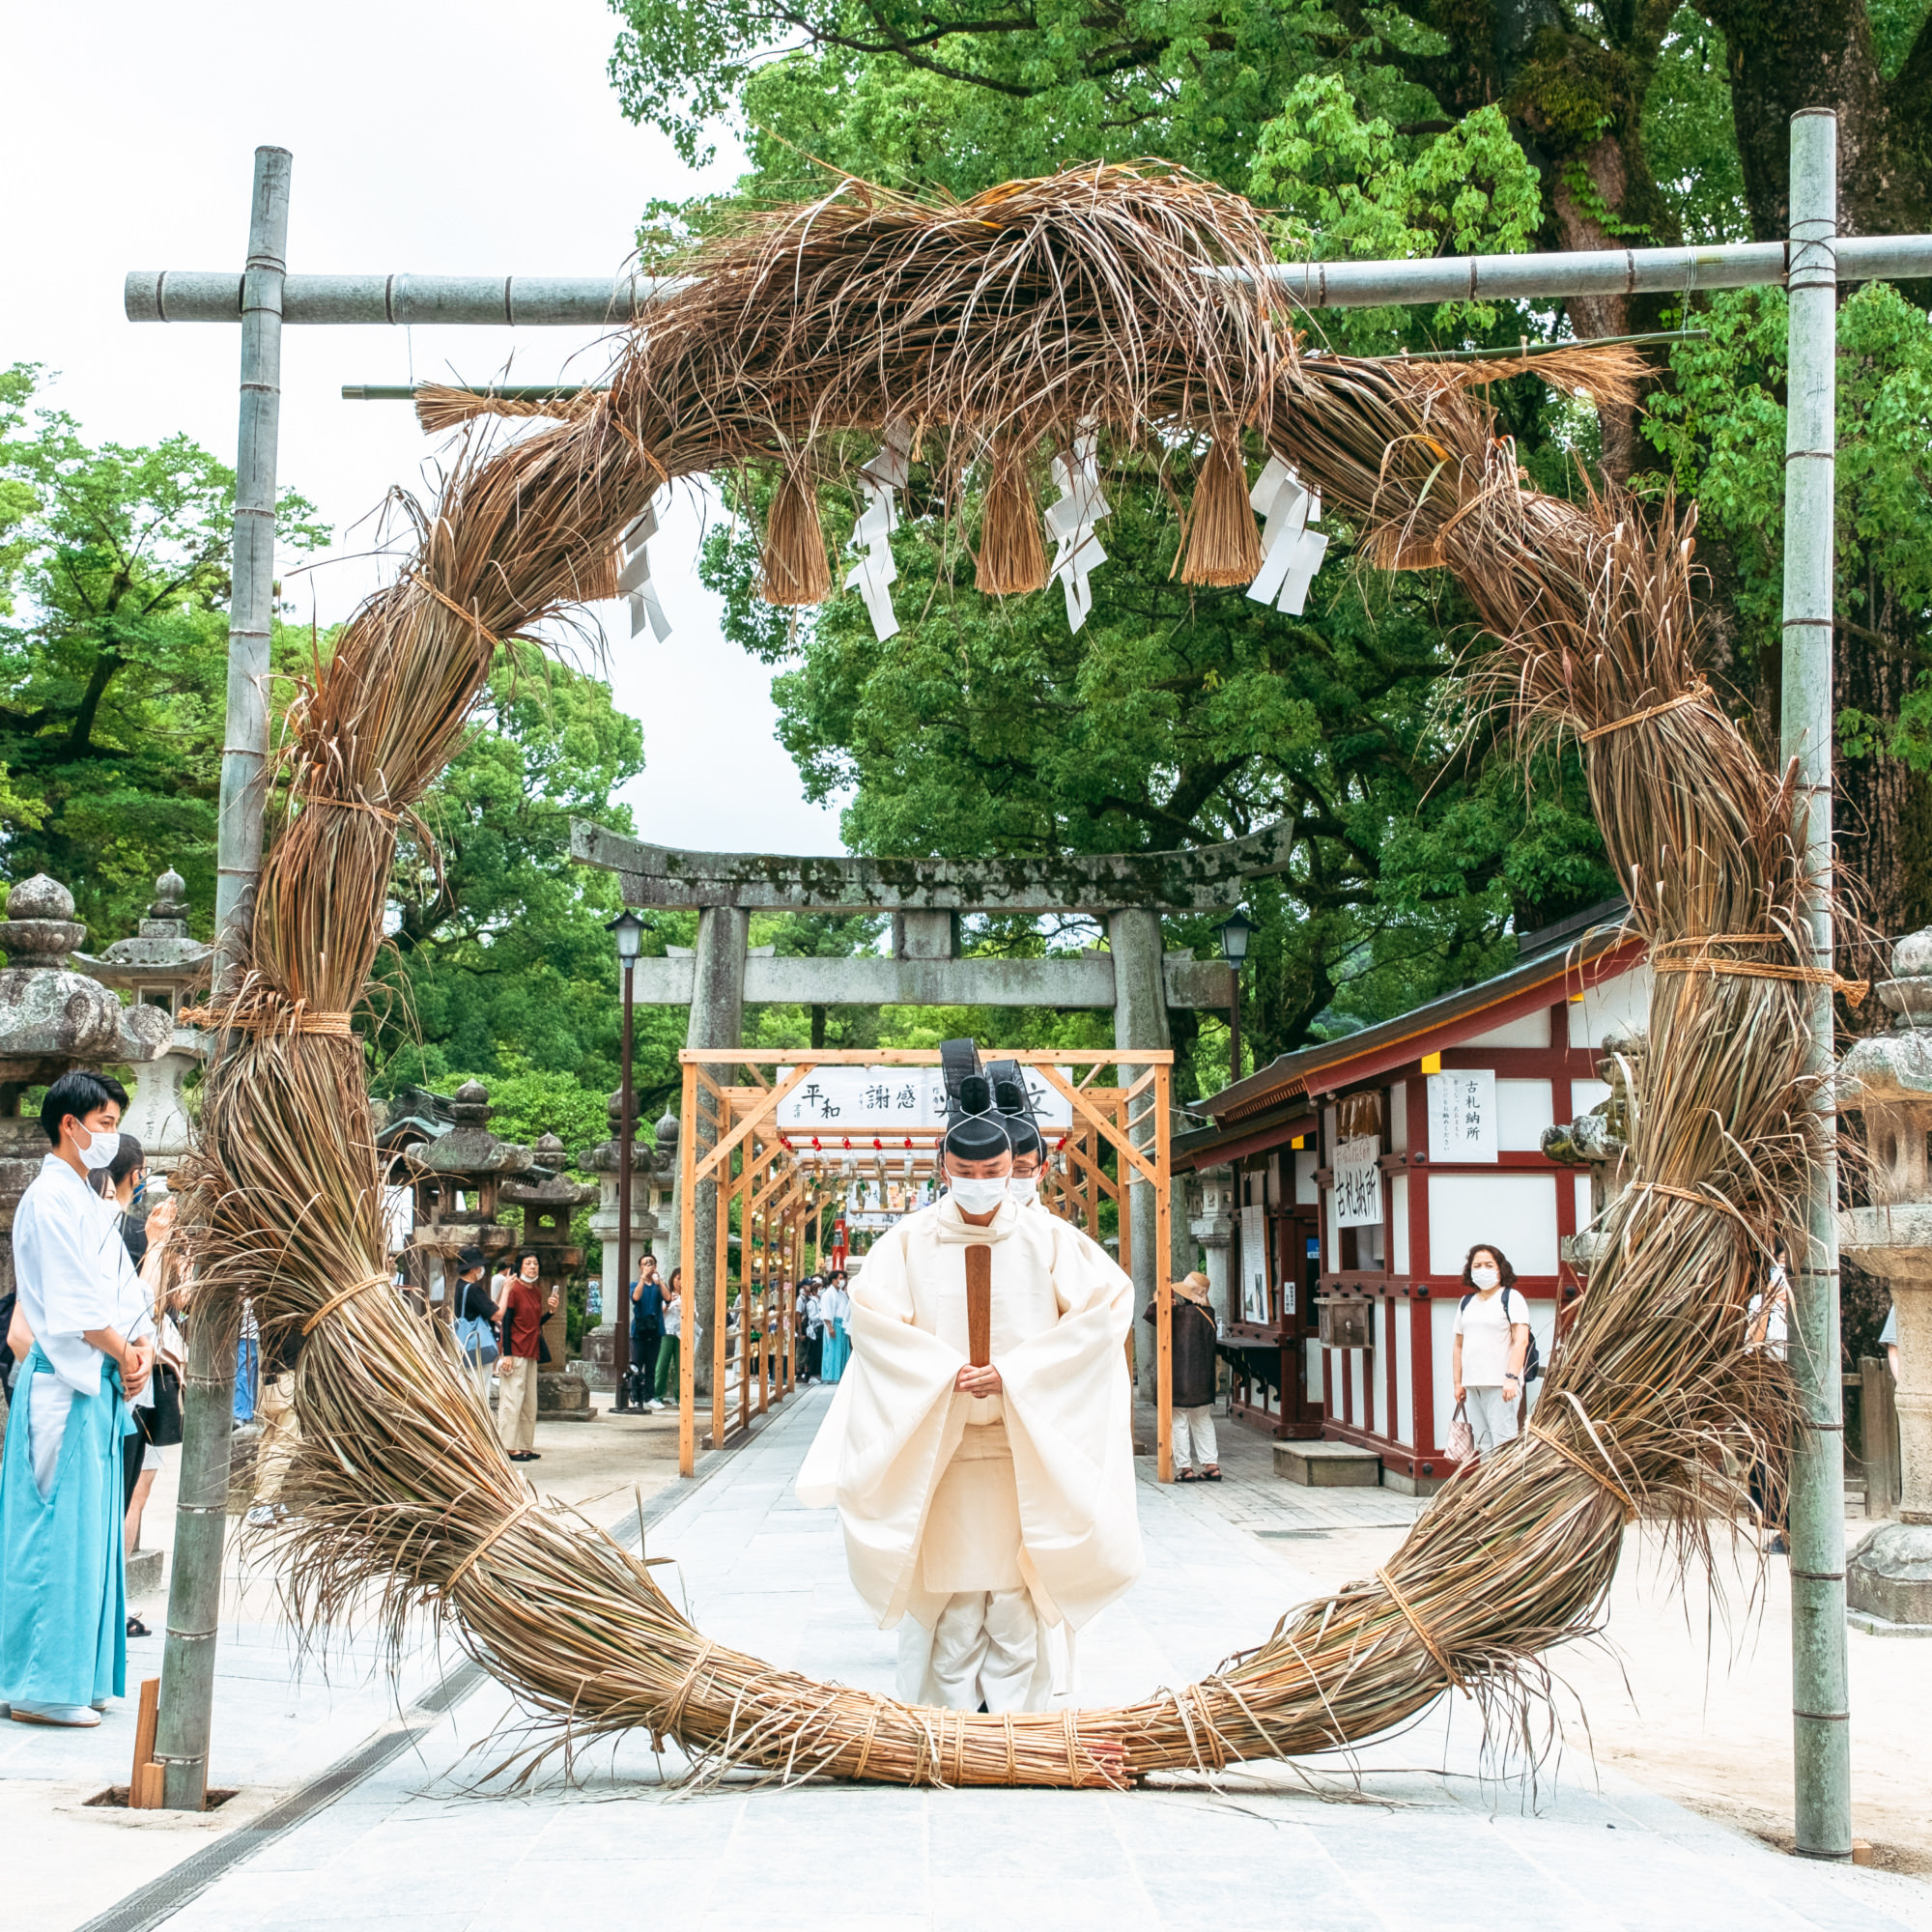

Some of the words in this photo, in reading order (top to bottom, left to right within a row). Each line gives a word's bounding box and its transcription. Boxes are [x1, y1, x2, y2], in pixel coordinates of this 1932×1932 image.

[1464, 1080, 1481, 1142] 古札納所
[1336, 1165, 1377, 1220] 古札納所
